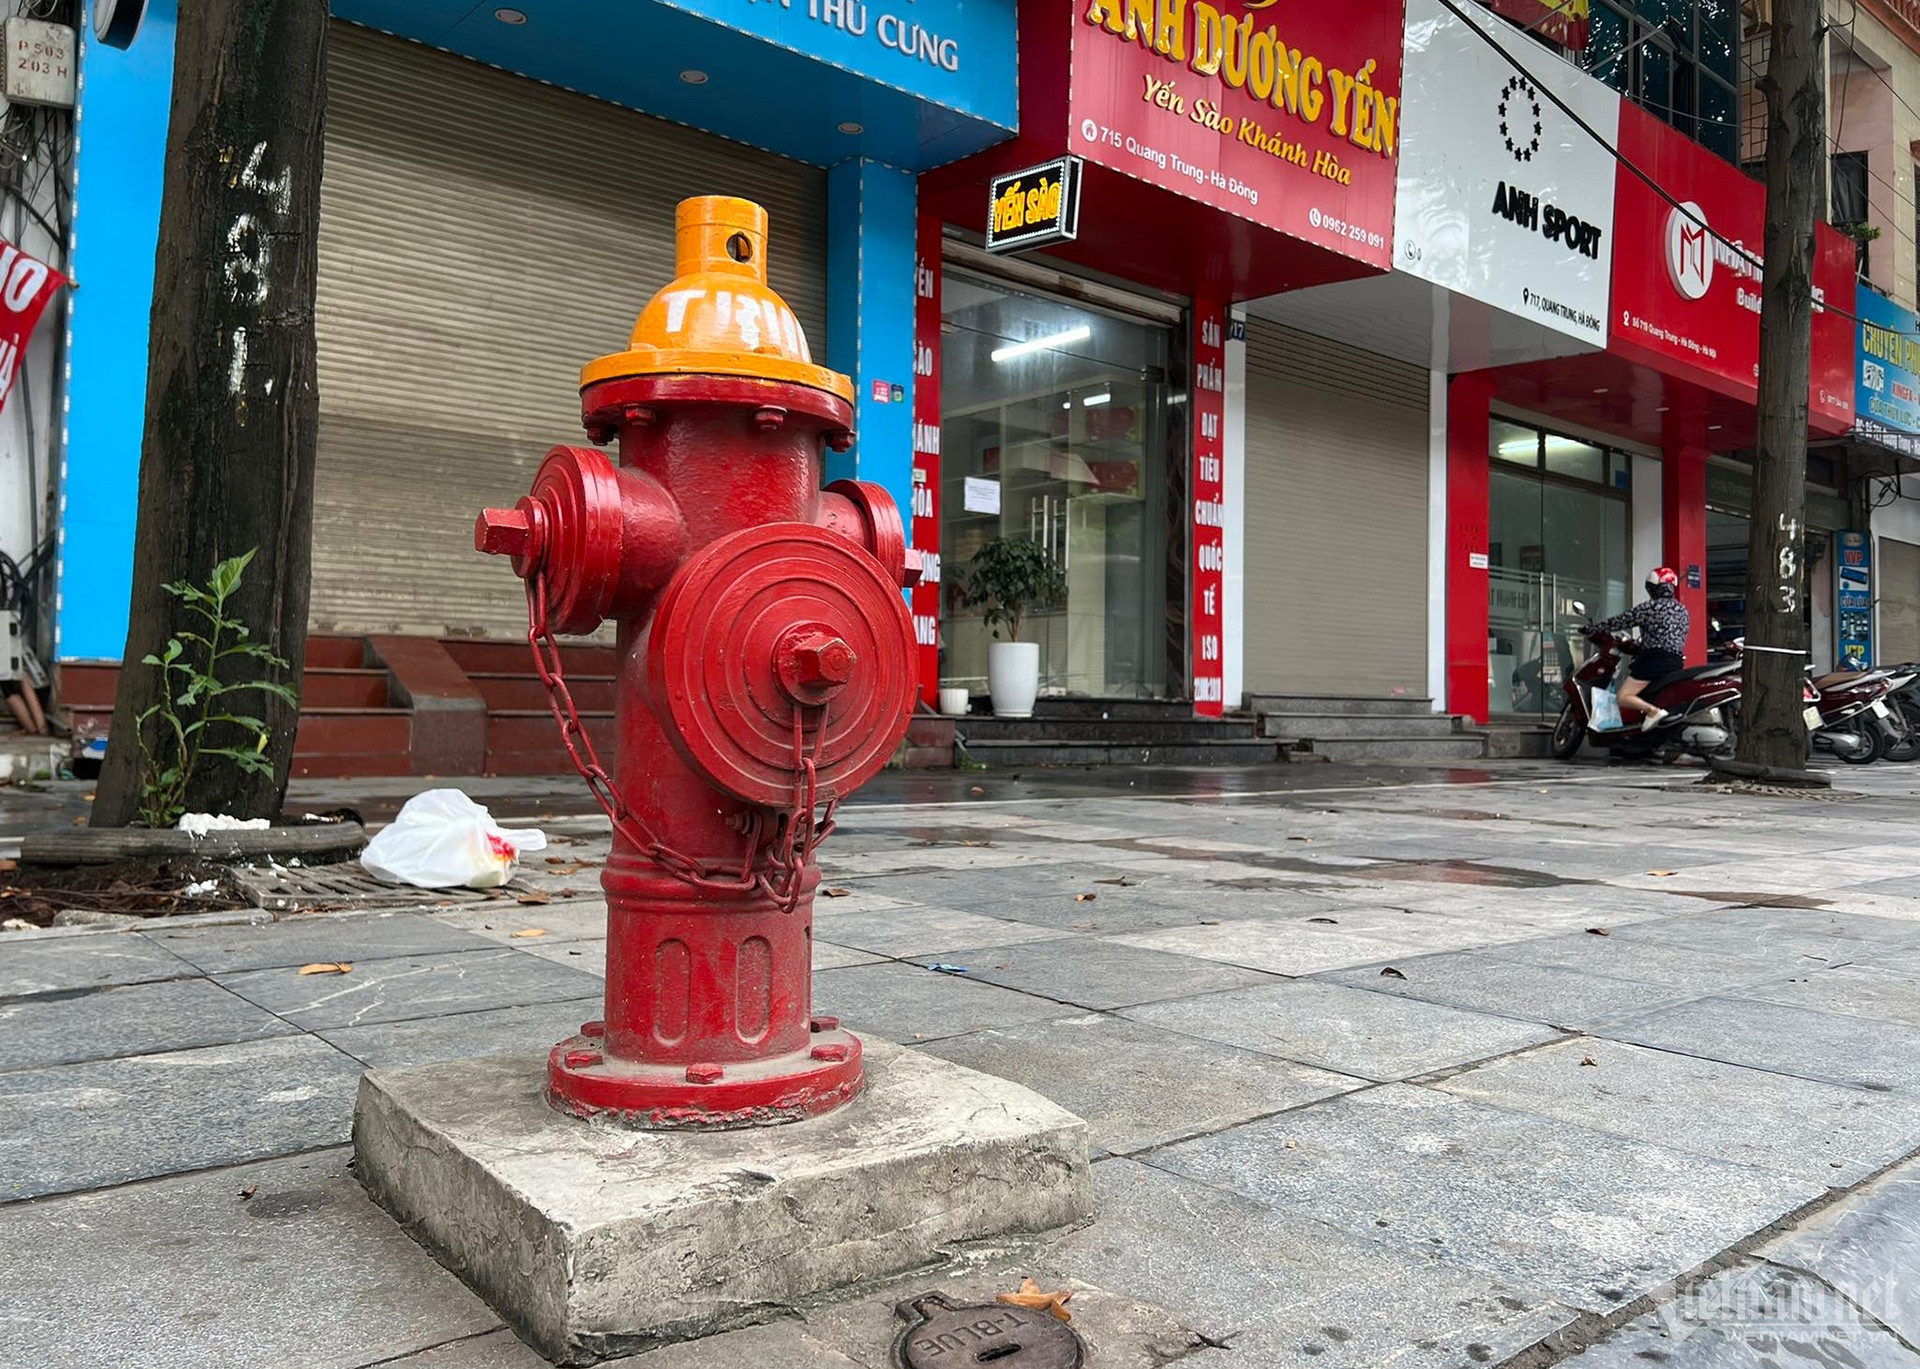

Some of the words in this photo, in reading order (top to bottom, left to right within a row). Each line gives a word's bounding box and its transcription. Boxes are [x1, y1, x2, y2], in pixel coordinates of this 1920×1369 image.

[34, 43, 64, 60] 503
[877, 14, 959, 71] CƯNG
[18, 57, 50, 75] 203
[1192, 2, 1324, 123] DƯƠNG
[1327, 58, 1397, 160] YẾN
[1143, 73, 1185, 115] Yến
[1191, 98, 1234, 134] Sào
[1238, 117, 1308, 168] Khánh
[1312, 149, 1351, 186] Hòa
[1100, 126, 1122, 149] 715
[1126, 136, 1167, 170] Quang
[1228, 177, 1258, 206] Đông
[993, 180, 1026, 233] YẾN
[1025, 176, 1061, 225] SÀO
[1491, 180, 1540, 232] ANH
[1542, 204, 1602, 260] SPORT
[1322, 214, 1347, 237] 0962
[1348, 224, 1367, 244] 259
[1367, 232, 1385, 251] 091
[1230, 322, 1244, 339] 17
[1203, 583, 1216, 616] TẾ
[1202, 634, 1218, 661] ISO
[914, 1312, 1030, 1357] T-BLUE
